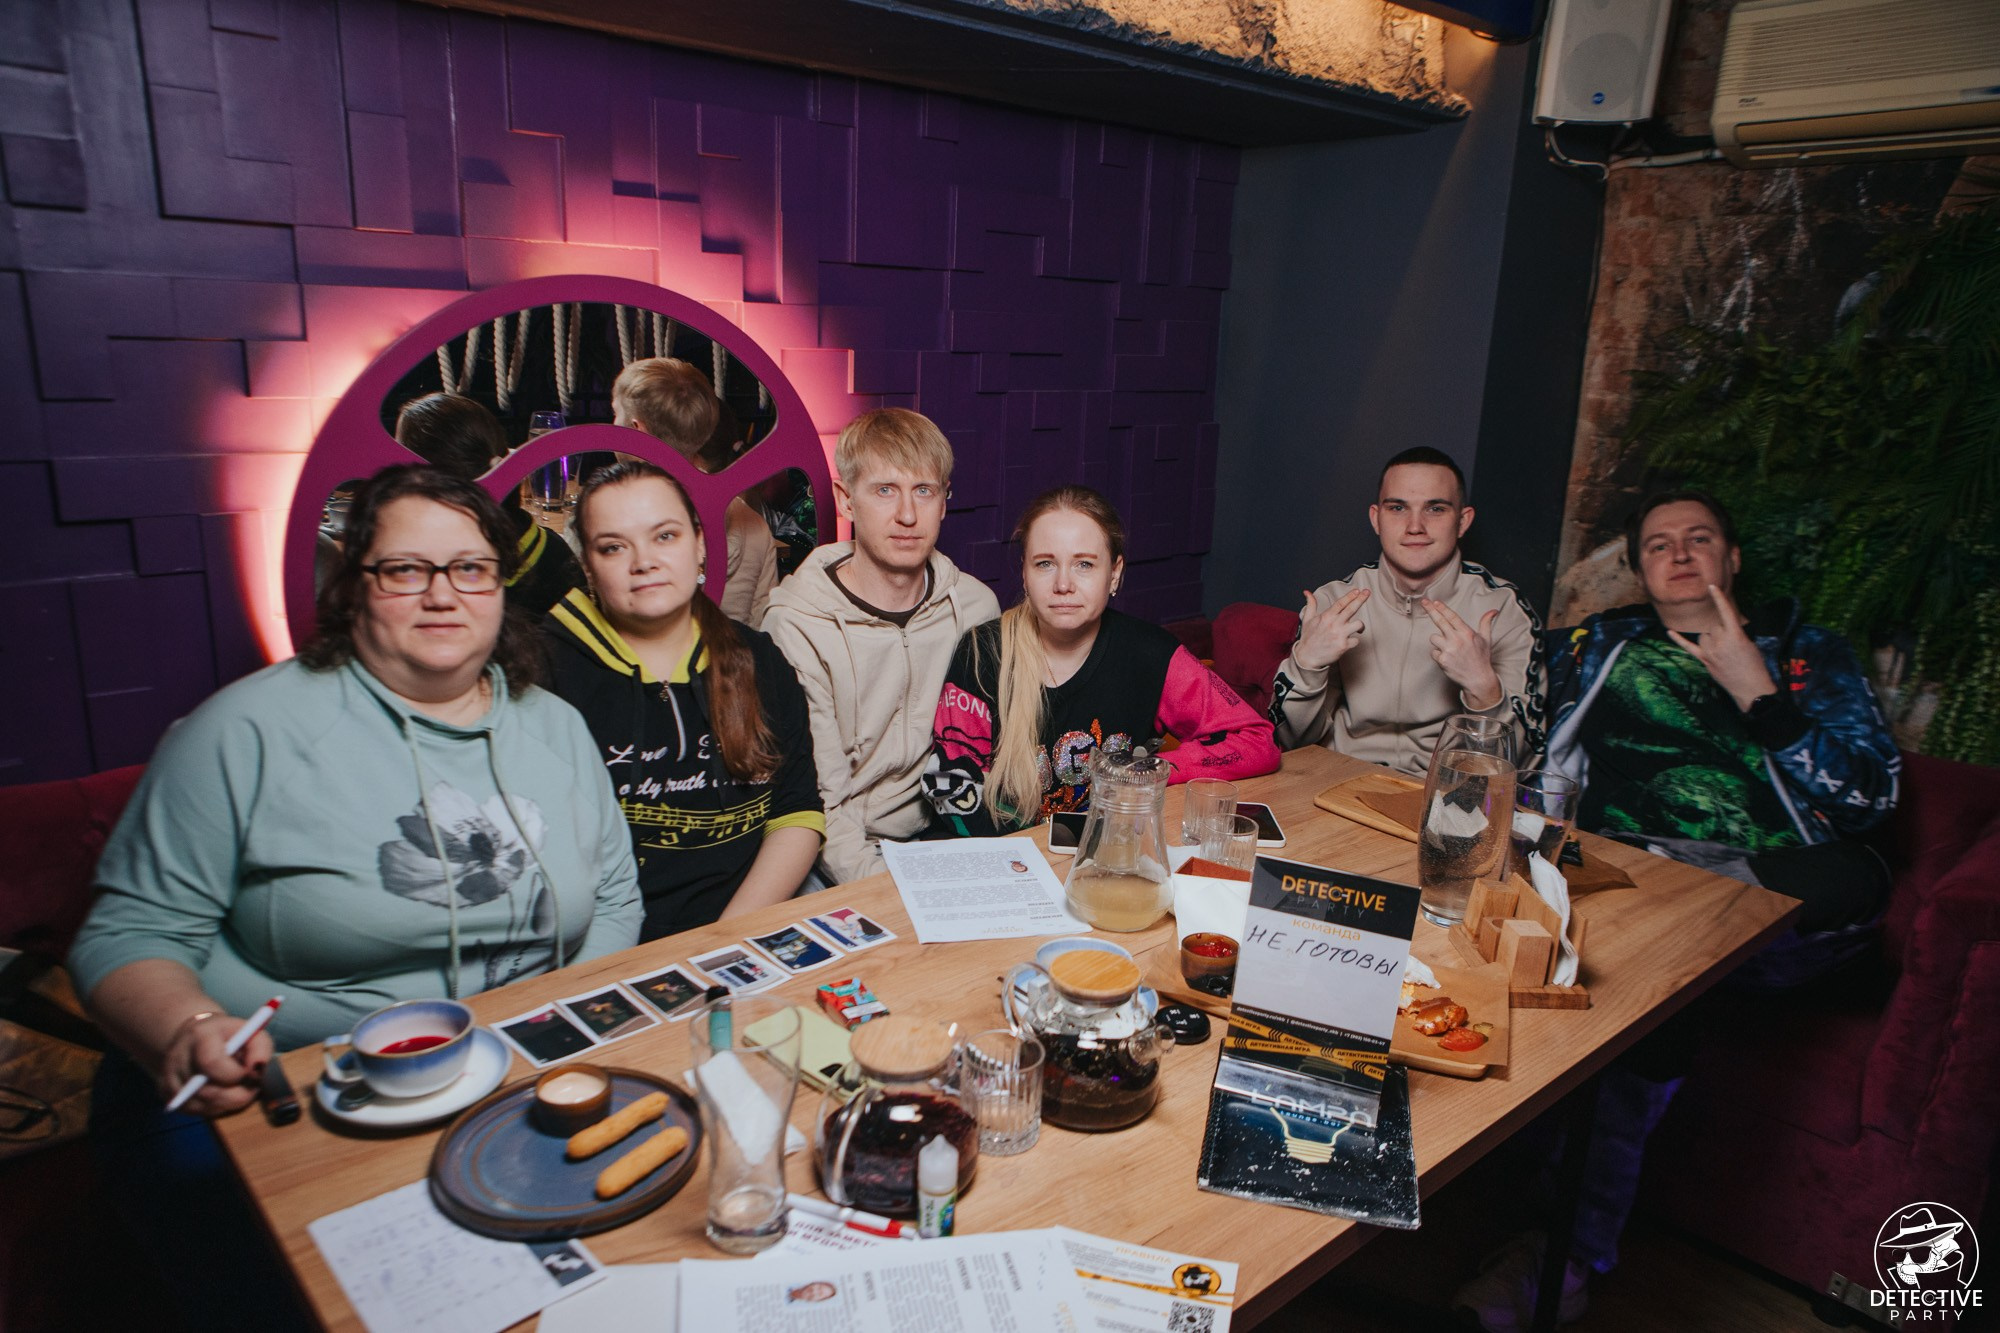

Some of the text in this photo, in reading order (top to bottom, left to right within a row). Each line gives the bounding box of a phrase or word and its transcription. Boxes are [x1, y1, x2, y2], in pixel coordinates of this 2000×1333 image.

[1281, 875, 1387, 912] DETECTIVE
[1297, 897, 1365, 918] PARTY
[1291, 918, 1361, 941] команда
[1247, 925, 1398, 976] НЕ ГОТОВЫ
